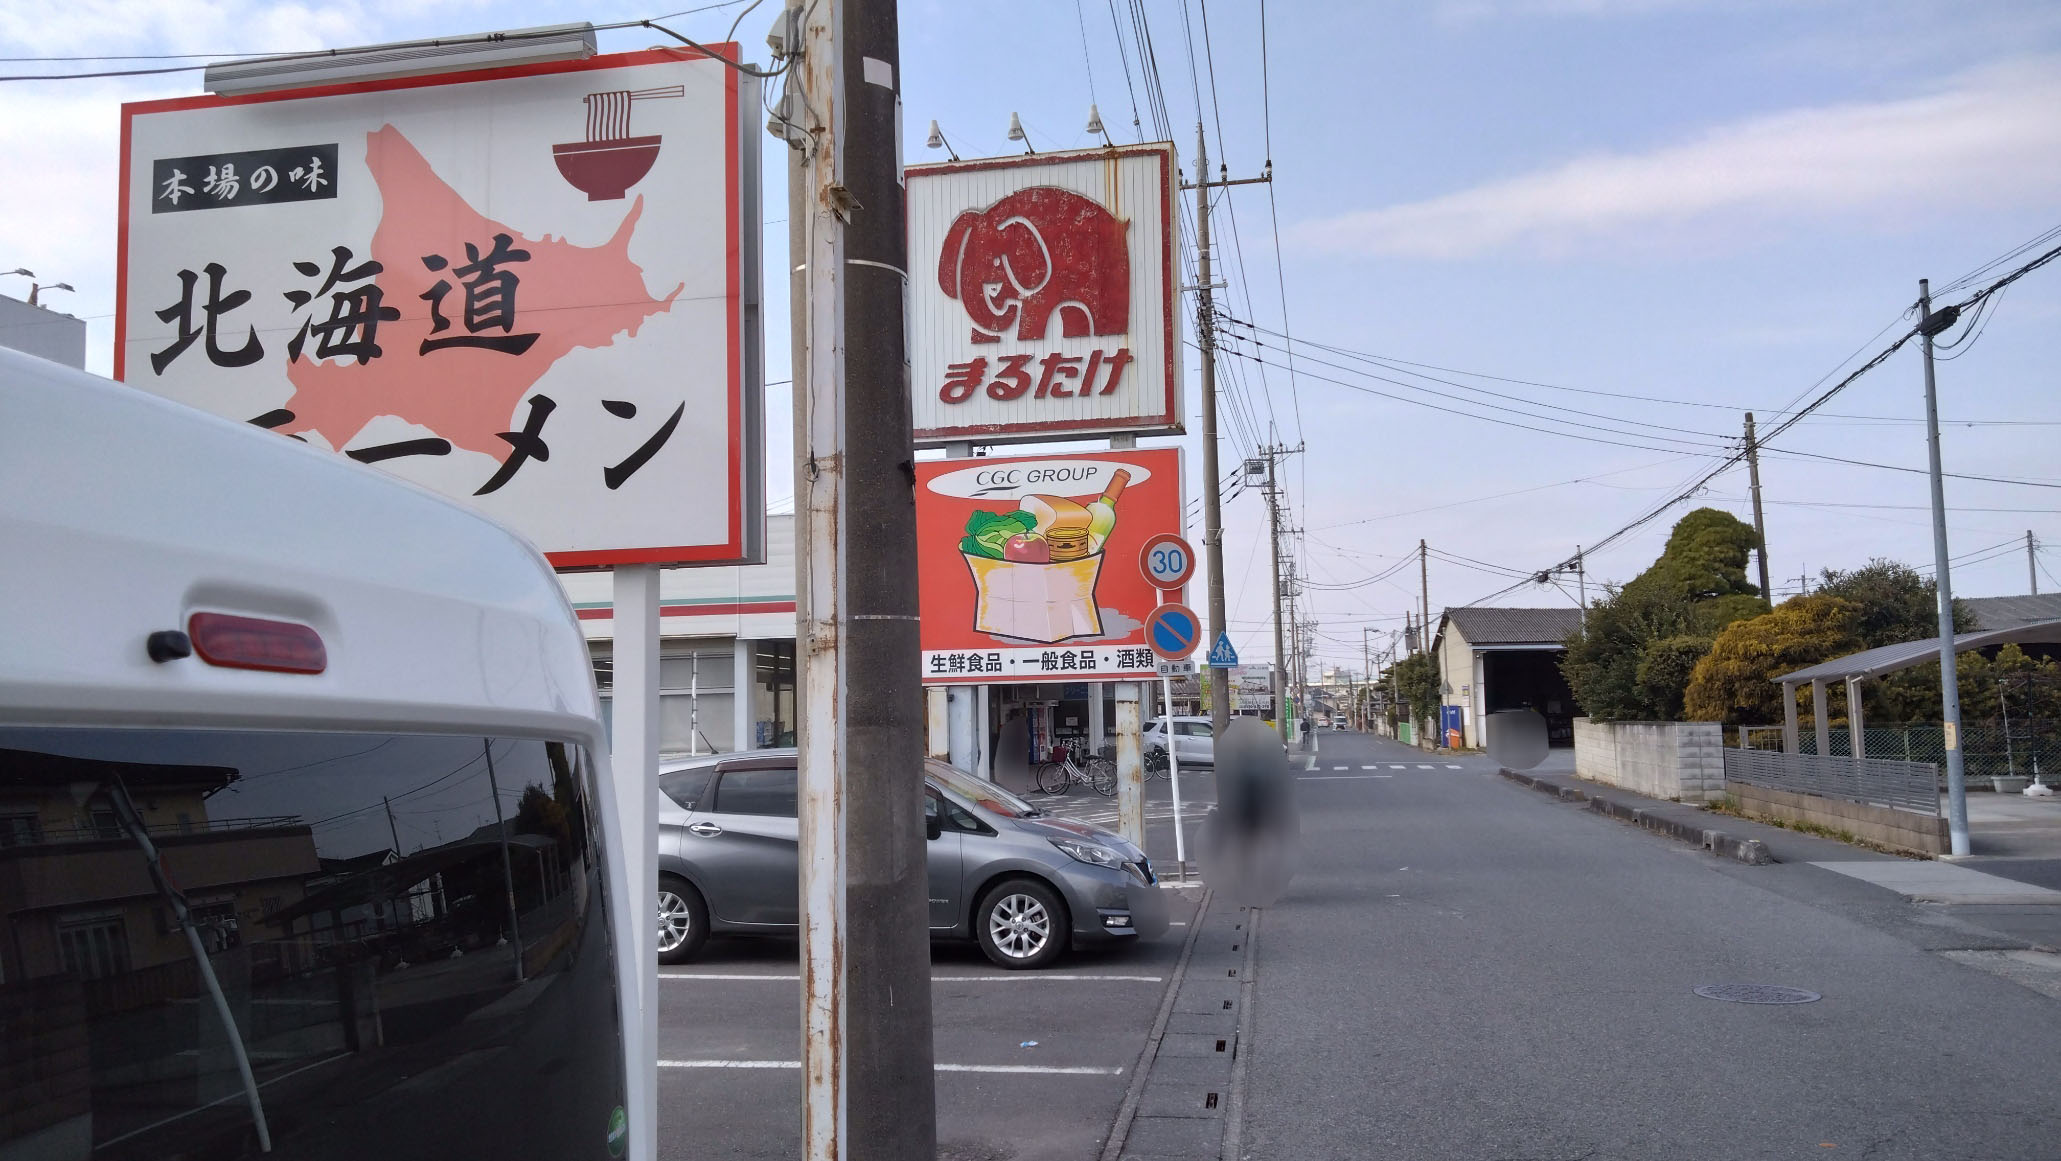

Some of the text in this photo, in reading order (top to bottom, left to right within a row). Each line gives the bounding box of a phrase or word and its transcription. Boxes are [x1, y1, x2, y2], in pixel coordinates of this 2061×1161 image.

[159, 157, 328, 206] 本場の味
[151, 233, 541, 376] 北海道
[939, 348, 1134, 404] まるたけ
[976, 467, 1098, 485] CGC GROUP
[1153, 549, 1183, 574] 30
[1160, 663, 1192, 674] 自動車
